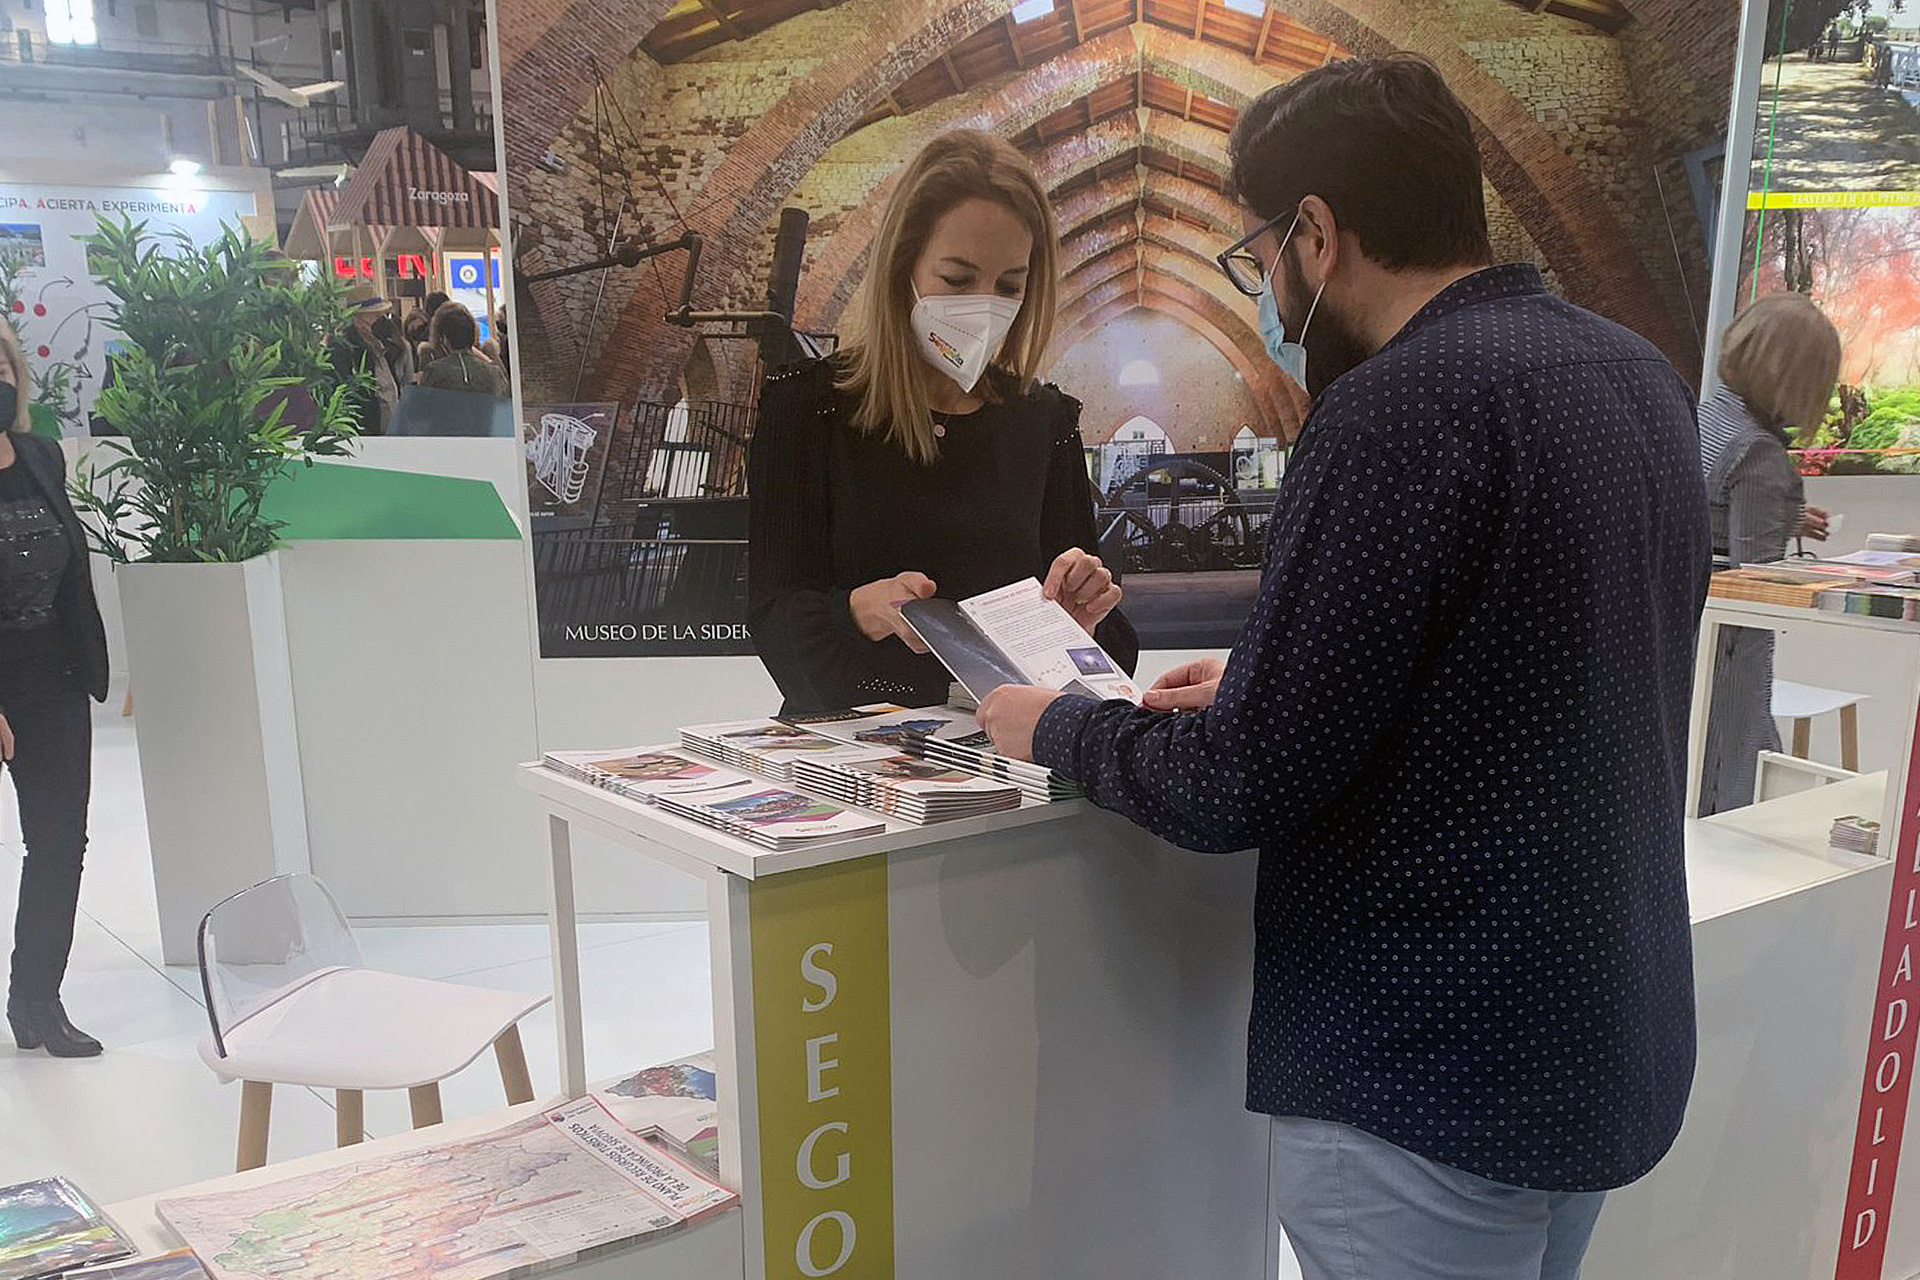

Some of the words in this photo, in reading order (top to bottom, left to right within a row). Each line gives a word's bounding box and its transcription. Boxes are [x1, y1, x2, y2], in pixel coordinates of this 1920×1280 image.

[409, 187, 469, 204] Zaragoza
[103, 200, 196, 214] EXPERIMENTA
[565, 625, 637, 641] MUSEO
[642, 625, 668, 640] DE
[673, 625, 697, 640] LA
[795, 942, 857, 1278] SEGO
[587, 1122, 620, 1146] SEGOVIA
[651, 1180, 683, 1202] PLANO
